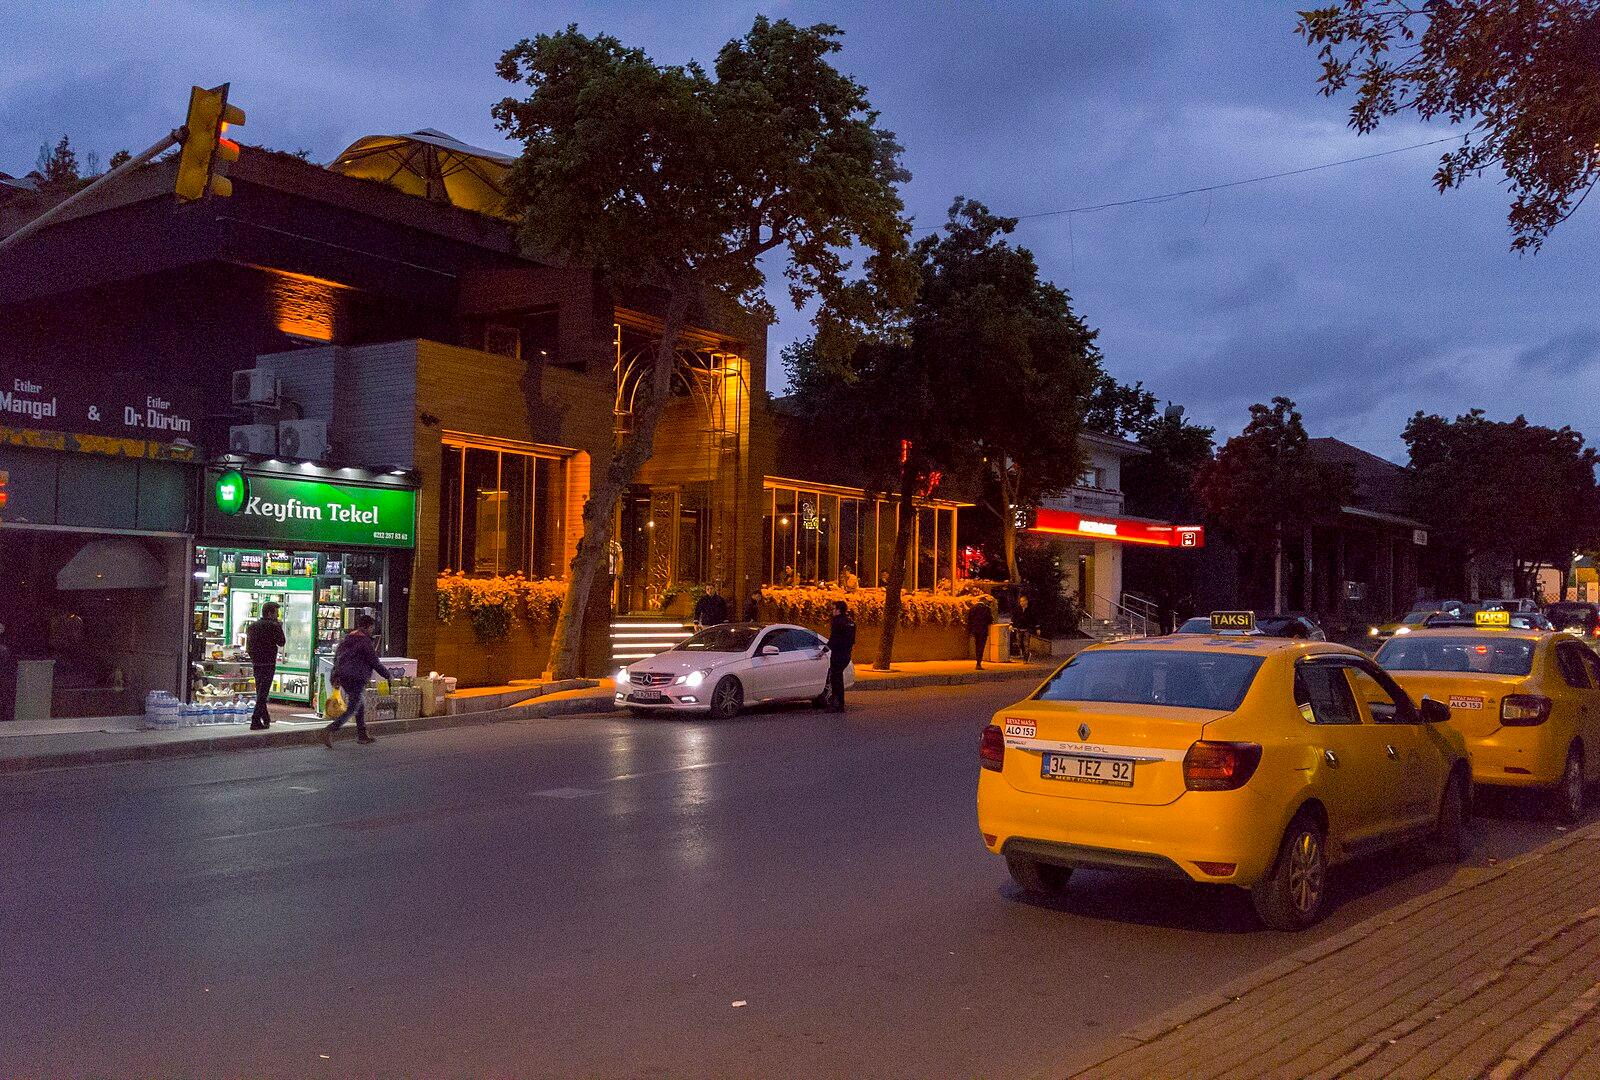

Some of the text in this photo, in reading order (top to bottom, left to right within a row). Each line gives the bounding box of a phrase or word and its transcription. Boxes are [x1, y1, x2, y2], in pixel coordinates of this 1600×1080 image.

[14, 378, 42, 393] Etiler
[0, 390, 56, 419] Mangal
[147, 396, 170, 409] Etiler
[88, 405, 101, 421] &
[124, 406, 191, 432] Dr. Dürüm
[245, 496, 379, 525] Keyfim Tekel
[1006, 726, 1035, 736] ALO 153
[1059, 743, 1109, 753] SYMBOL
[1051, 757, 1129, 779] 34 TEZ 92
